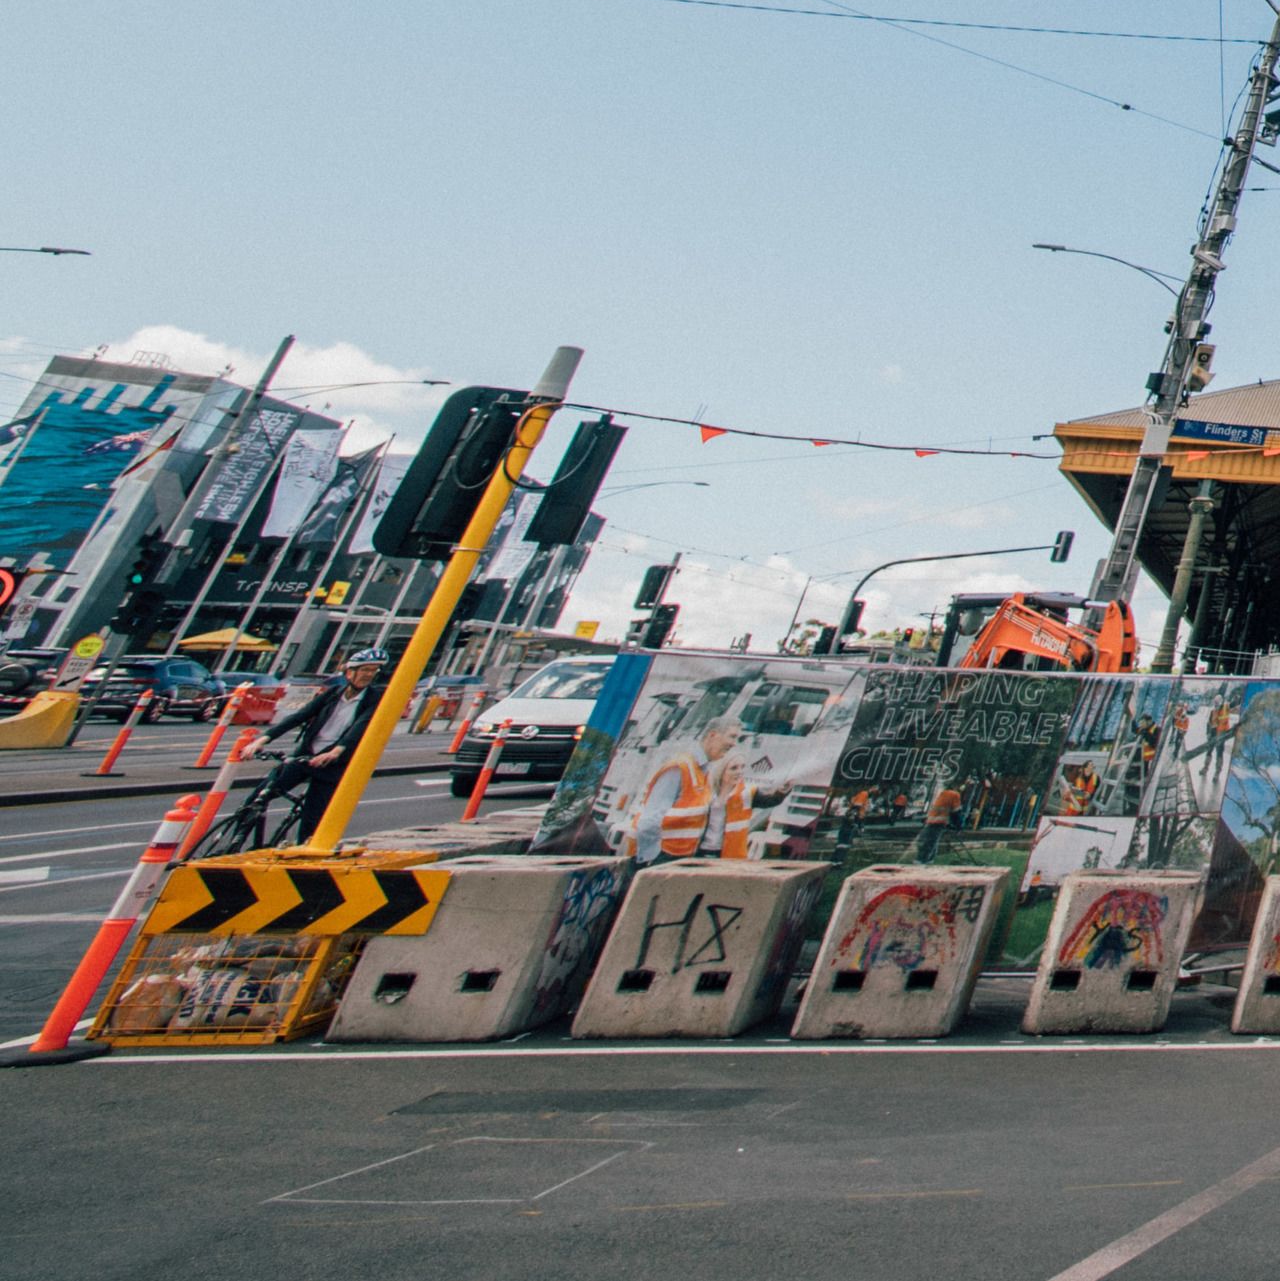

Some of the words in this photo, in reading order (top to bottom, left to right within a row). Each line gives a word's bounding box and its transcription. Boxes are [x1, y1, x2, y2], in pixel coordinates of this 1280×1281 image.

[1204, 423, 1248, 437] Flinders
[1251, 428, 1263, 440] St
[1031, 632, 1068, 656] HITACHI
[866, 670, 1049, 707] SHAPING
[876, 707, 1059, 745] LIVEABLE
[841, 746, 964, 781] CITIES
